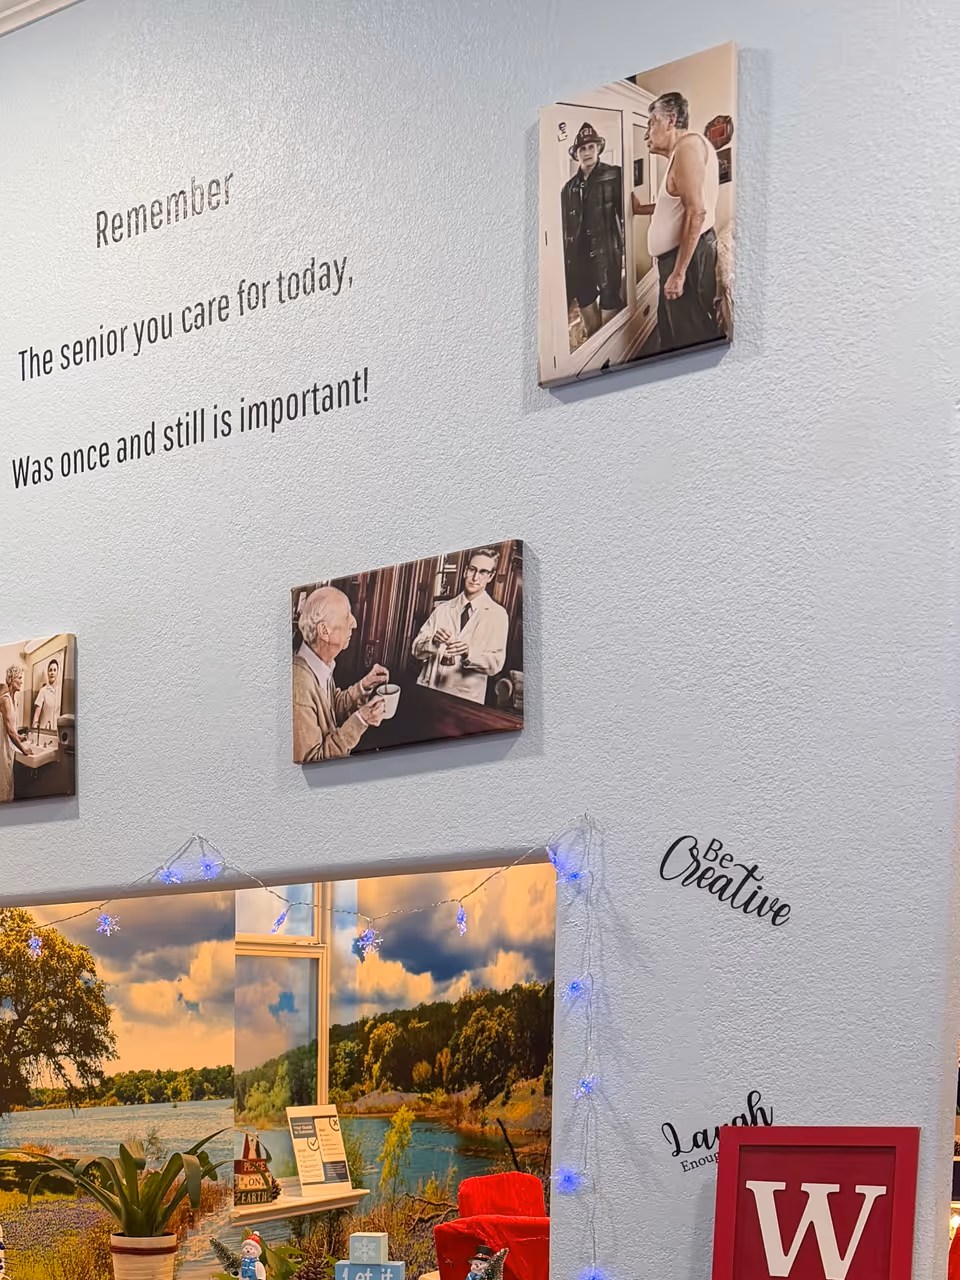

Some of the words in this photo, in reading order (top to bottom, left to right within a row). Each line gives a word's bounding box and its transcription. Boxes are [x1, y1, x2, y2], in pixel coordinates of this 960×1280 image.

[96, 172, 234, 248] Remember
[18, 346, 53, 381] The
[60, 324, 129, 370] senior
[133, 312, 173, 357] you
[182, 294, 230, 333] care
[237, 278, 271, 316] for
[276, 256, 354, 305] today,
[12, 455, 54, 489] Was
[60, 441, 110, 477] once
[117, 421, 156, 463] and
[164, 407, 205, 451] still
[213, 403, 232, 439] is
[240, 366, 369, 434] important!
[702, 838, 734, 869] Be
[659, 835, 791, 926] Creative
[248, 1177, 262, 1186] ON
[680, 1152, 720, 1173] Enoug
[241, 1192, 267, 1203] EARTH
